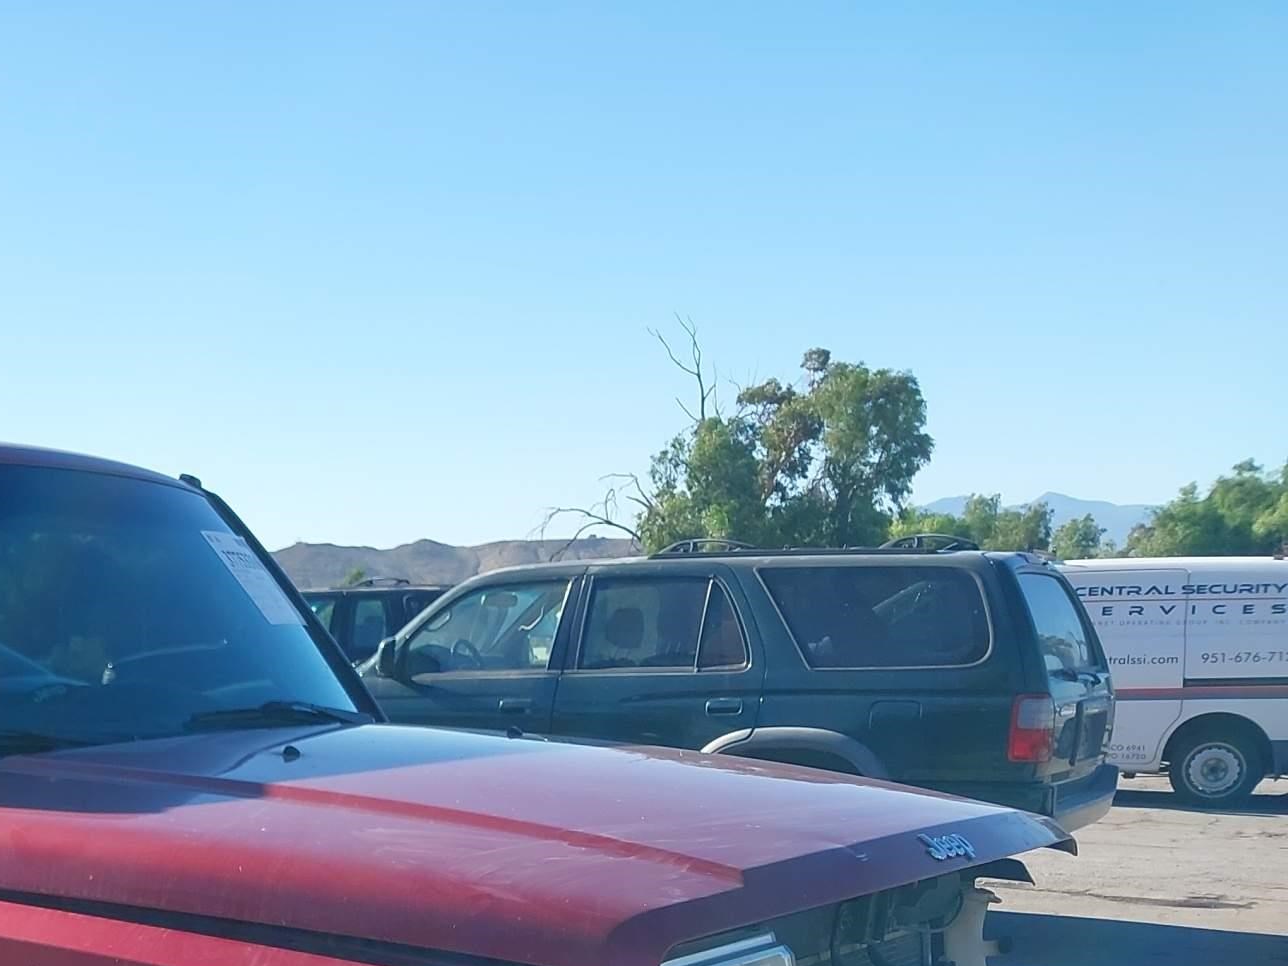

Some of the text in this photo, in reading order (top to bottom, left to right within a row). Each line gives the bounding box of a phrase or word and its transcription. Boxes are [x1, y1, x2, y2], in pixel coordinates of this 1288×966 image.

[1075, 583, 1288, 597] CENTRAL SECURITY
[1101, 603, 1287, 616] ERVICES
[1108, 653, 1179, 665] tralssi.com
[917, 833, 976, 860] Jeep
